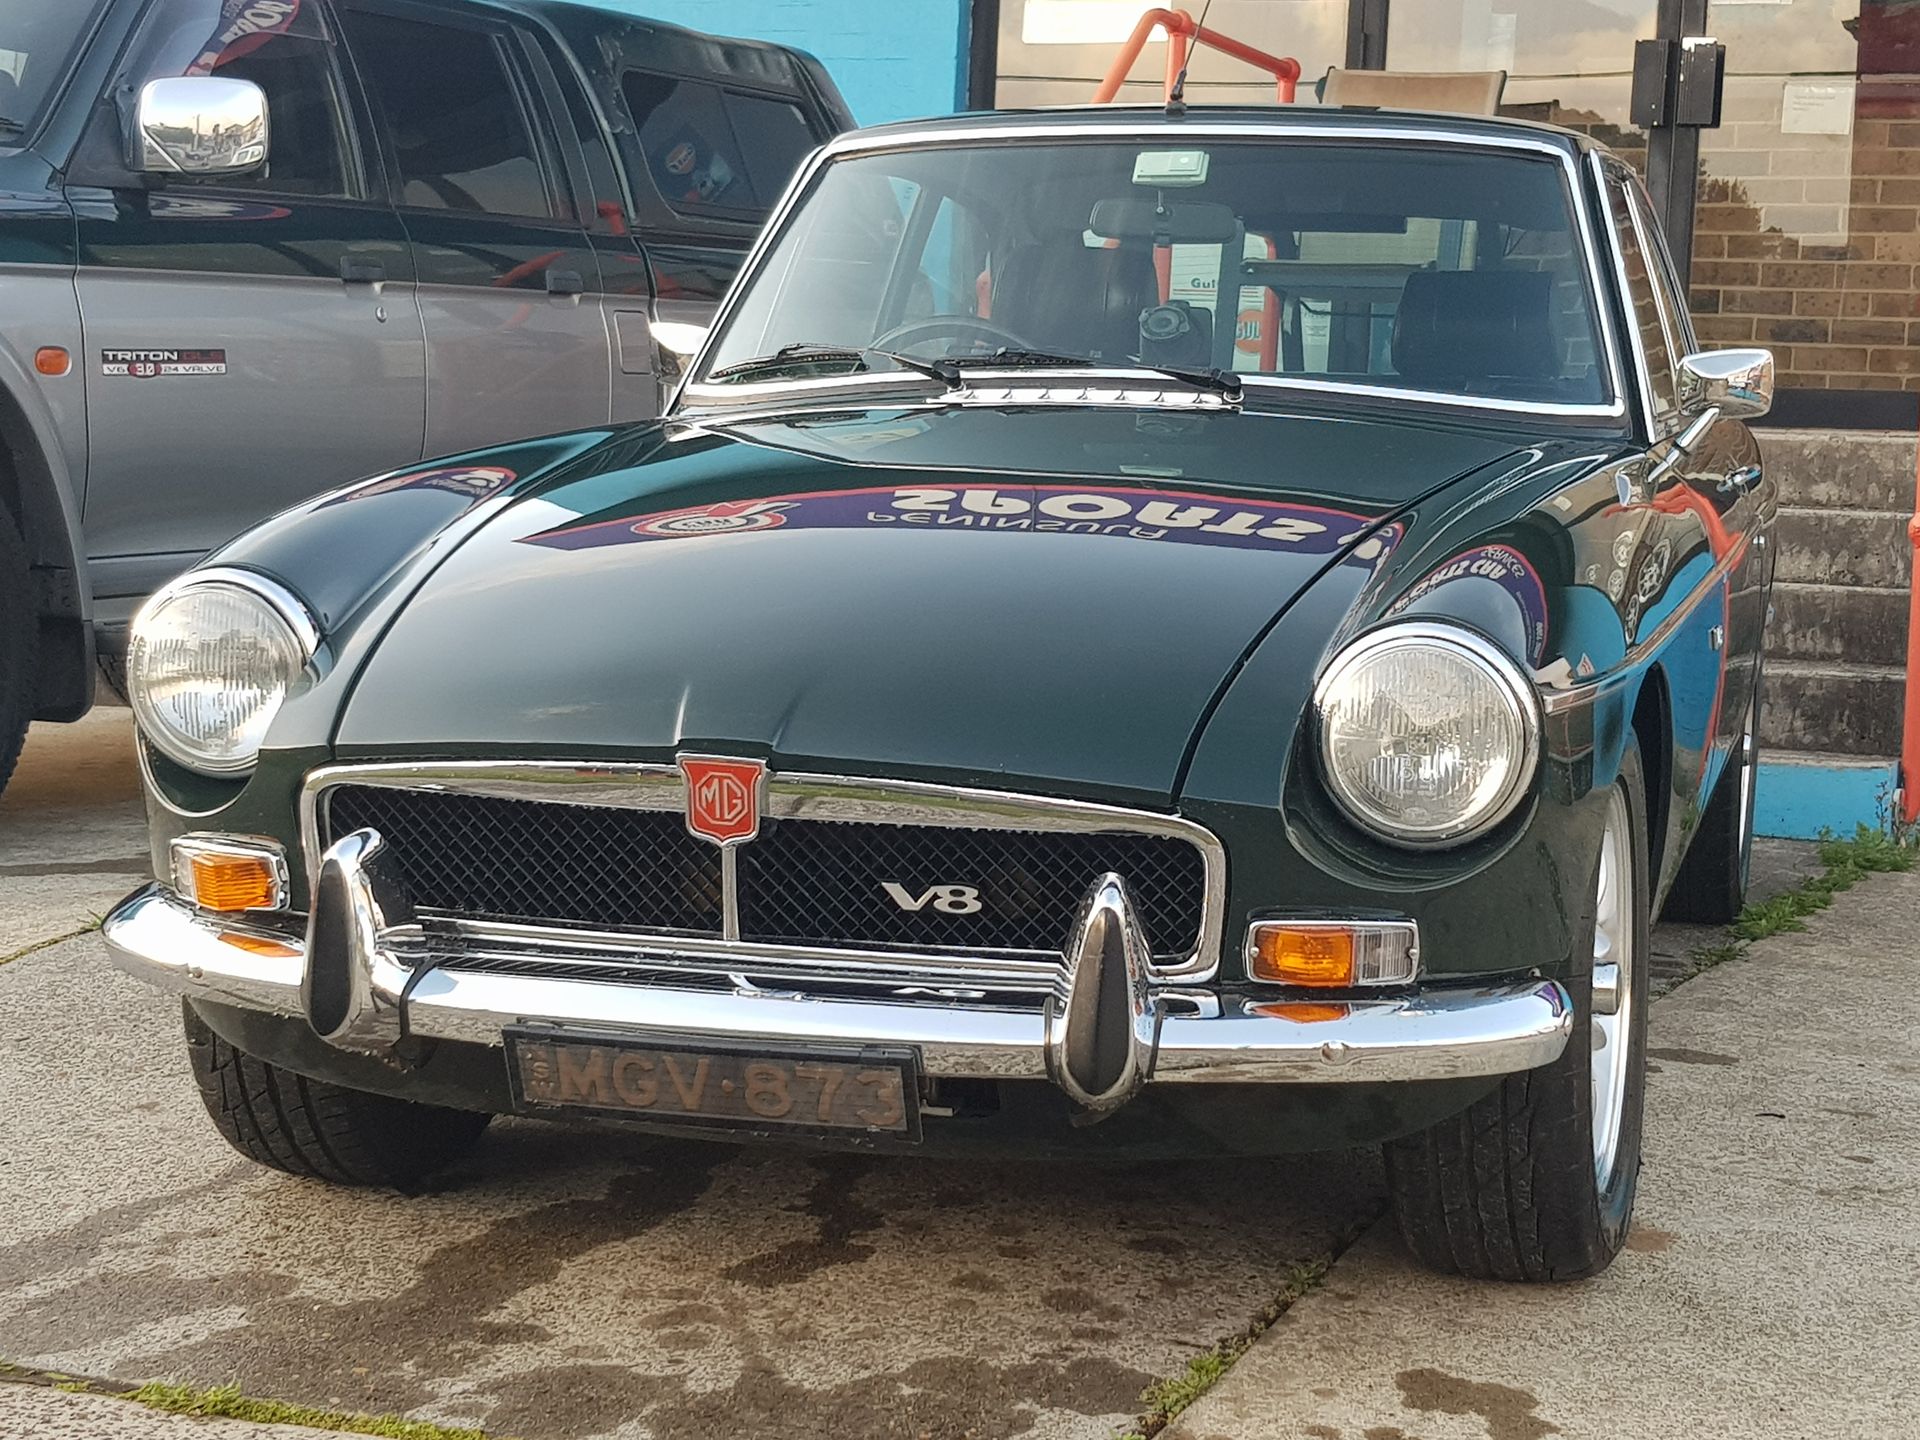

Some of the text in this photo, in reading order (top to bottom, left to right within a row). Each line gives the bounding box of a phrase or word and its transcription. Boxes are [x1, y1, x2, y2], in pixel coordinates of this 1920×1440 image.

[103, 351, 179, 361] TRITON
[107, 366, 126, 374] V6
[182, 365, 224, 373] VALVE
[701, 778, 743, 819] MG
[881, 882, 982, 914] V8
